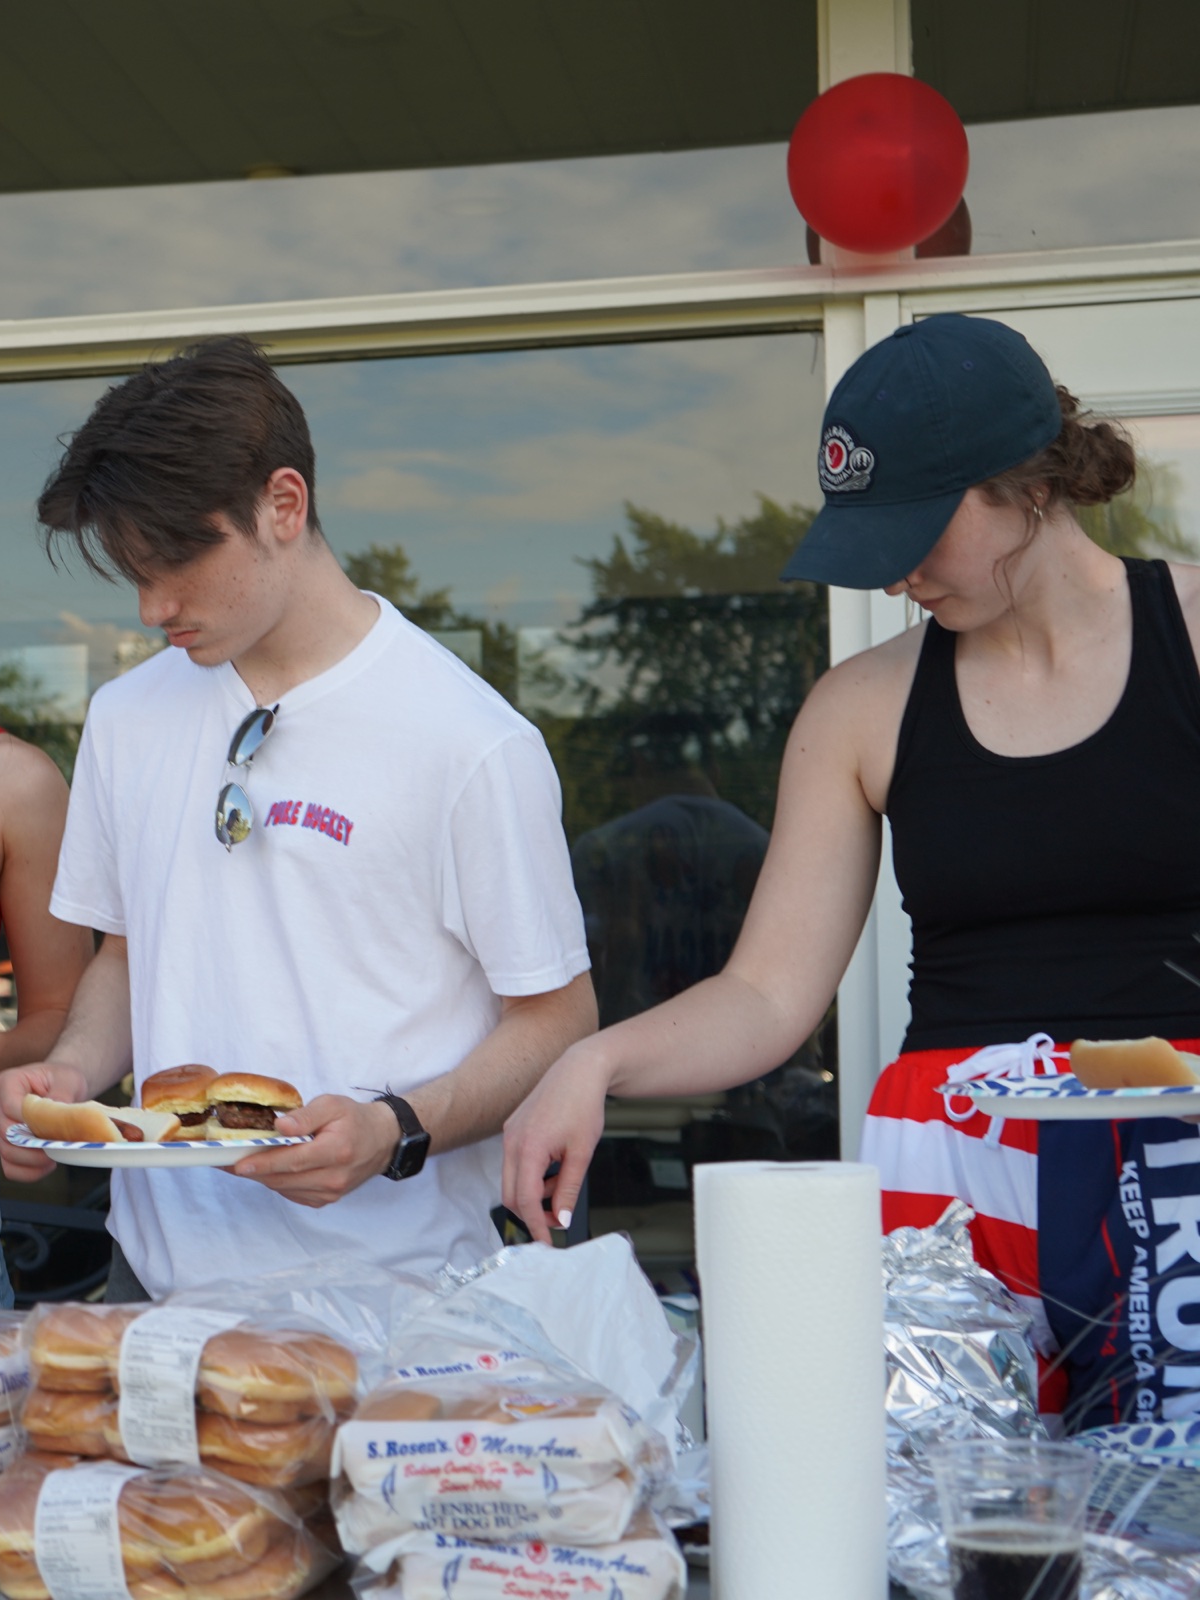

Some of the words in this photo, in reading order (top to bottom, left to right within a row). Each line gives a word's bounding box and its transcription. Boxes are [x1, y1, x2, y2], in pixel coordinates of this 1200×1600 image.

[301, 802, 354, 846] HOCKEY
[1118, 1160, 1150, 1239] KEEP
[1142, 1119, 1200, 1425] TRU
[1127, 1244, 1157, 1381] AMERICA
[384, 1437, 451, 1458] Rosen's
[439, 1500, 528, 1516] ENRICHED
[452, 1513, 490, 1530] DOG
[494, 1511, 540, 1528] BUNS
[552, 1547, 608, 1572] Mary
